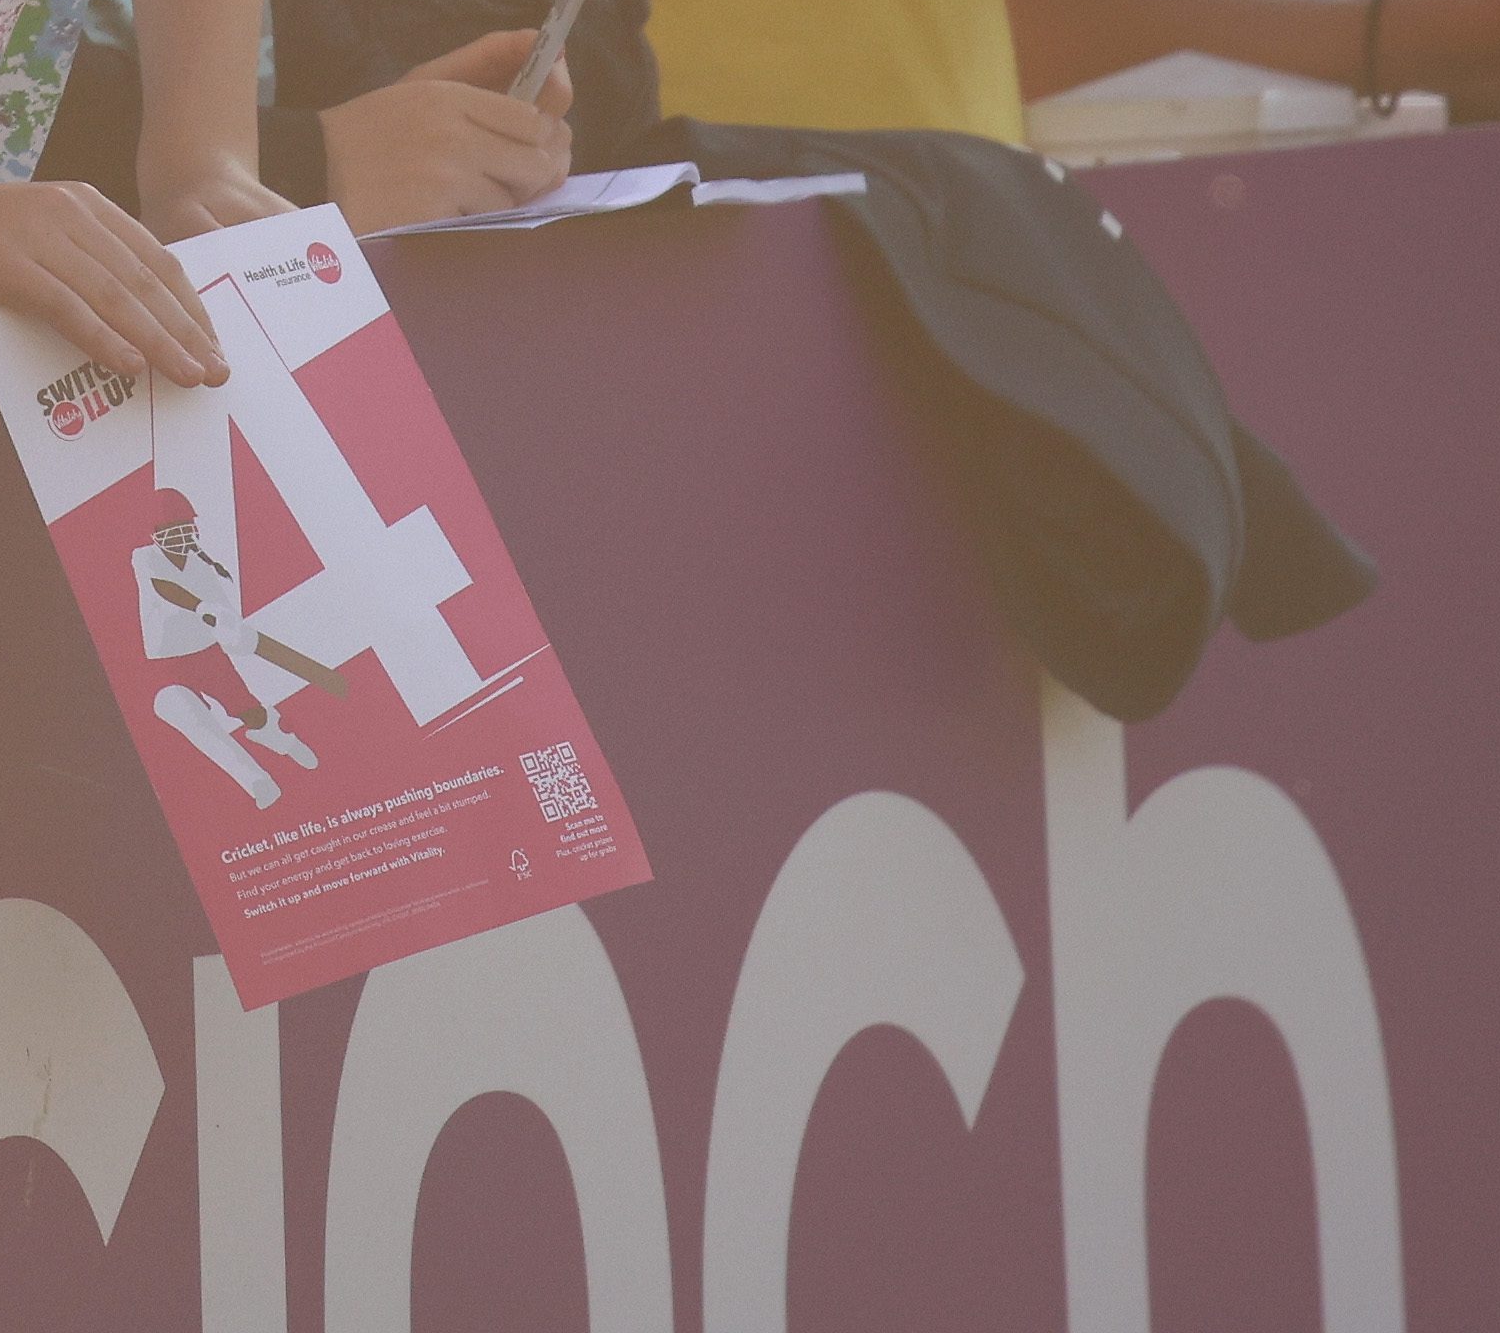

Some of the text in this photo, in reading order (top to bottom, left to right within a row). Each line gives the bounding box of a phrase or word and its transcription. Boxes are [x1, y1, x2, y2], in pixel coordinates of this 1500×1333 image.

[243, 258, 306, 283] Health & Life
[274, 272, 312, 287] insurance
[37, 360, 115, 417] SWITC
[102, 375, 136, 407] UP
[221, 765, 504, 864] Cricket, like life, is always pushing boundaries.
[229, 790, 491, 882] But we can all get caught in our crease and feel a bit stumped.
[560, 824, 608, 843] find out more
[565, 814, 604, 831] Scan me to
[237, 825, 448, 900] Find your energy and get back to loving exercise.
[243, 845, 446, 919] Switch it up and move forward with Vitality.
